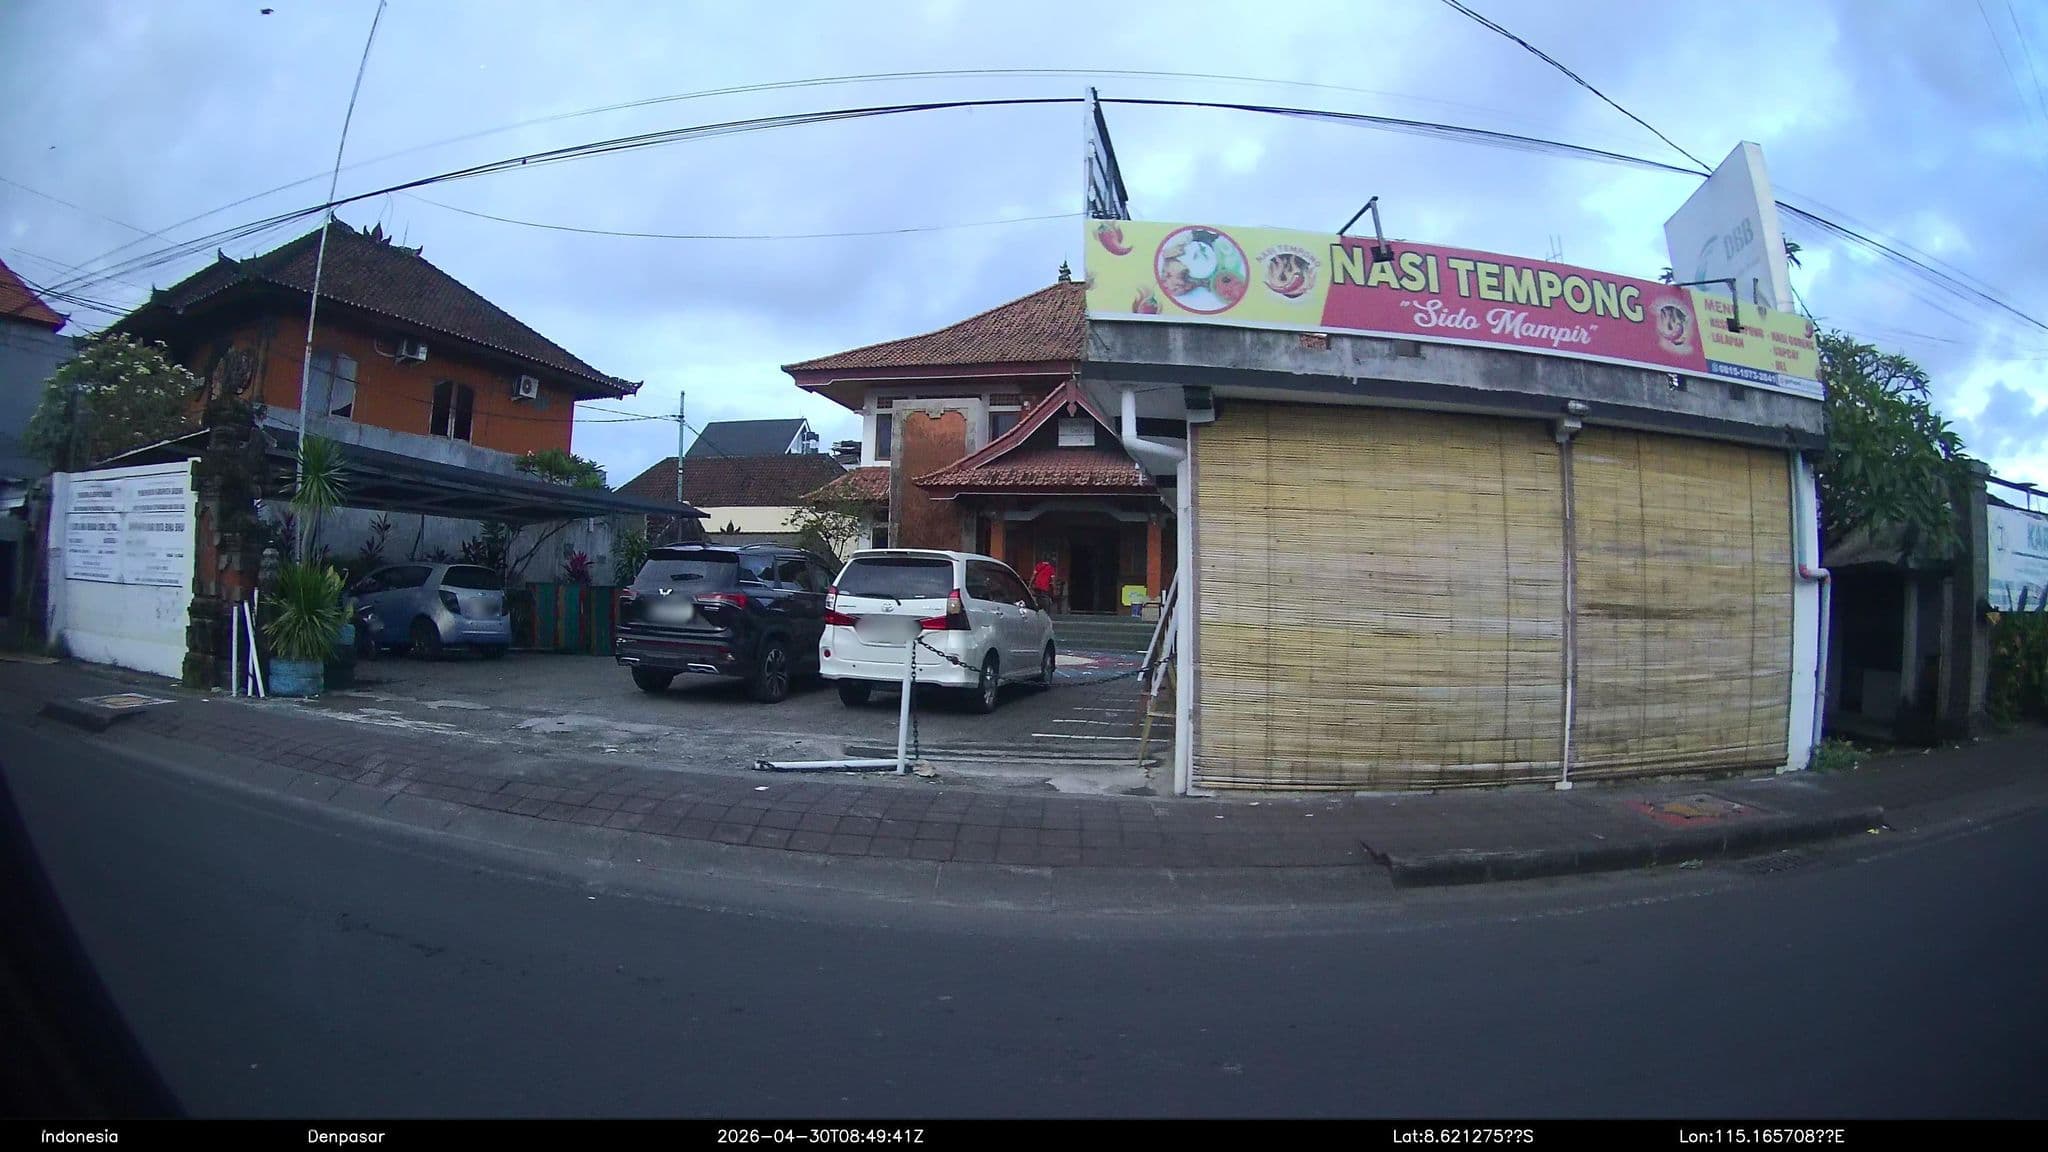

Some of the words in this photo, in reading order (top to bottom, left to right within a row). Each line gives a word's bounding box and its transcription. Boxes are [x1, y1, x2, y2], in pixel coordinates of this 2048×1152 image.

[1329, 243, 1440, 294] NASI
[1448, 257, 1645, 323] TEMPONG
[1704, 299, 1735, 316] MEN
